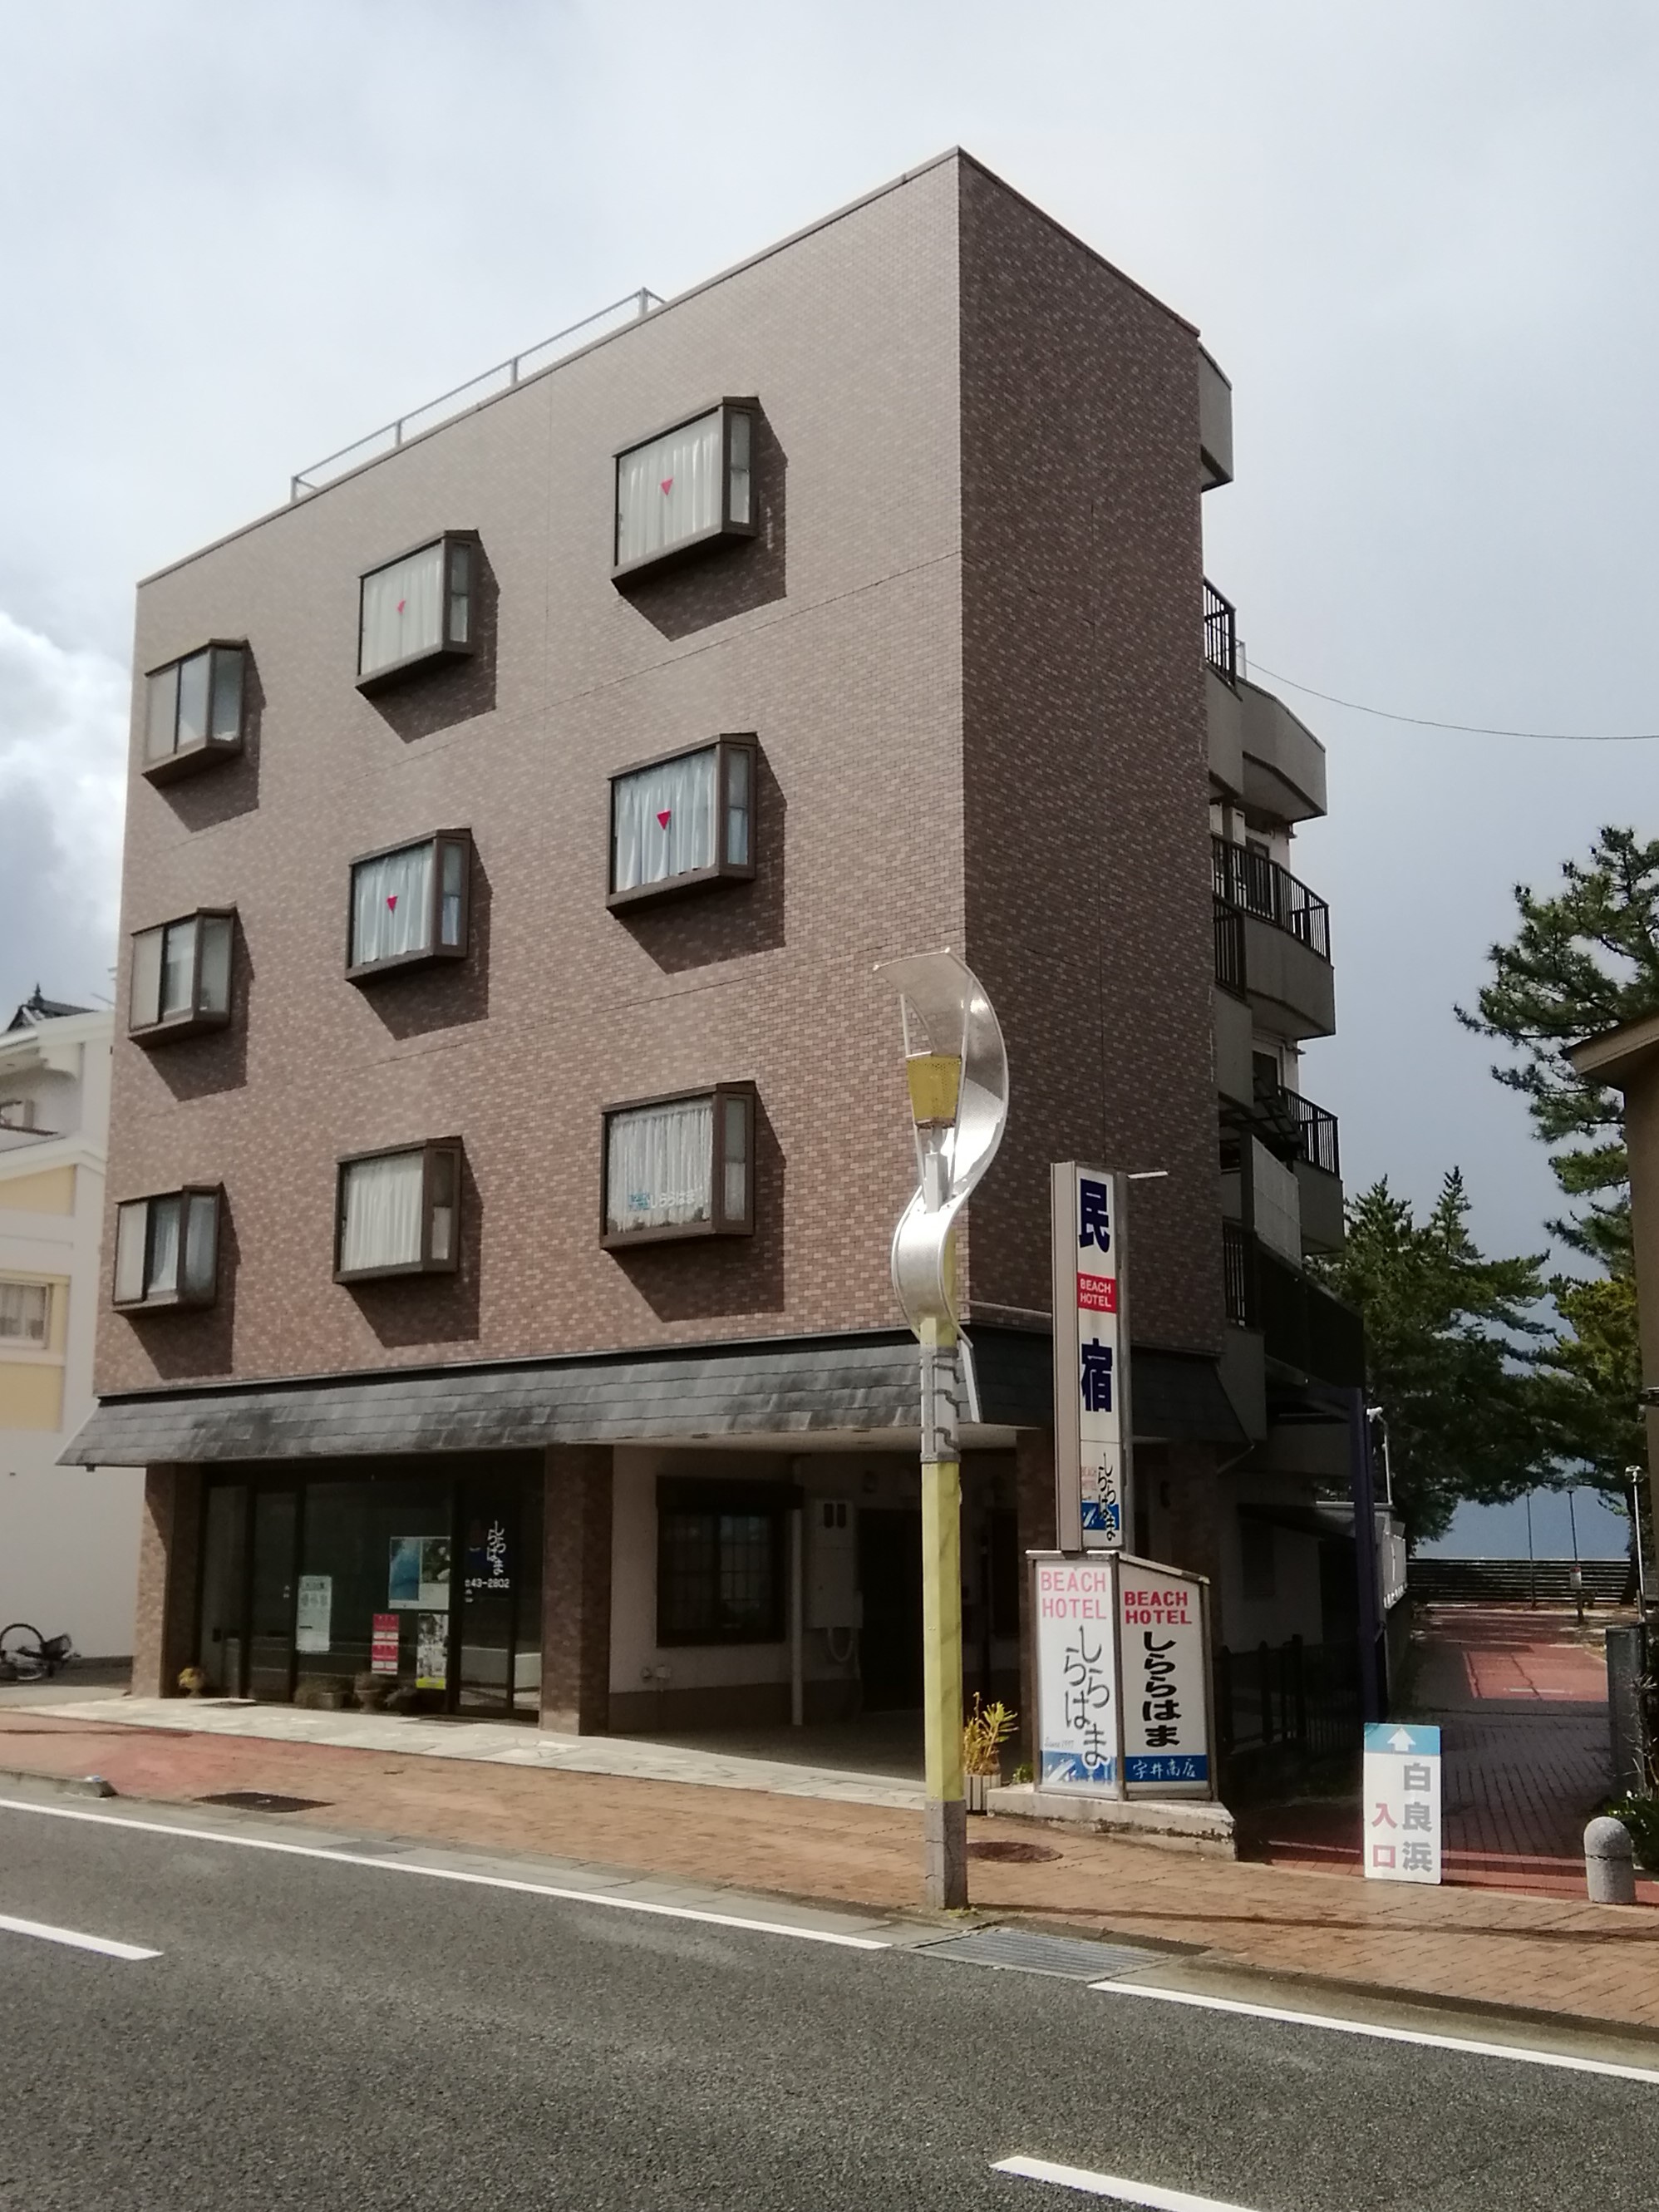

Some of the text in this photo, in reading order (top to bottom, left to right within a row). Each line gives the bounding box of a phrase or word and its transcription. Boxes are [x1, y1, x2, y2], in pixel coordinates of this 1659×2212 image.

[1080, 1277, 1112, 1294] BEACH
[1080, 1292, 1112, 1308] HOTEL
[1097, 1451, 1117, 1542] しららはま
[486, 1520, 507, 1576] しららはま
[1041, 1570, 1106, 1593] BEACH
[1124, 1590, 1188, 1607] BEACH
[1041, 1598, 1107, 1620] HOTEL
[1125, 1609, 1193, 1624] HOTEL
[1063, 1624, 1110, 1766] しららはま
[1142, 1631, 1183, 1748] しららはま
[1371, 1802, 1398, 1869] 入口
[1401, 1761, 1433, 1873] 白良浜
